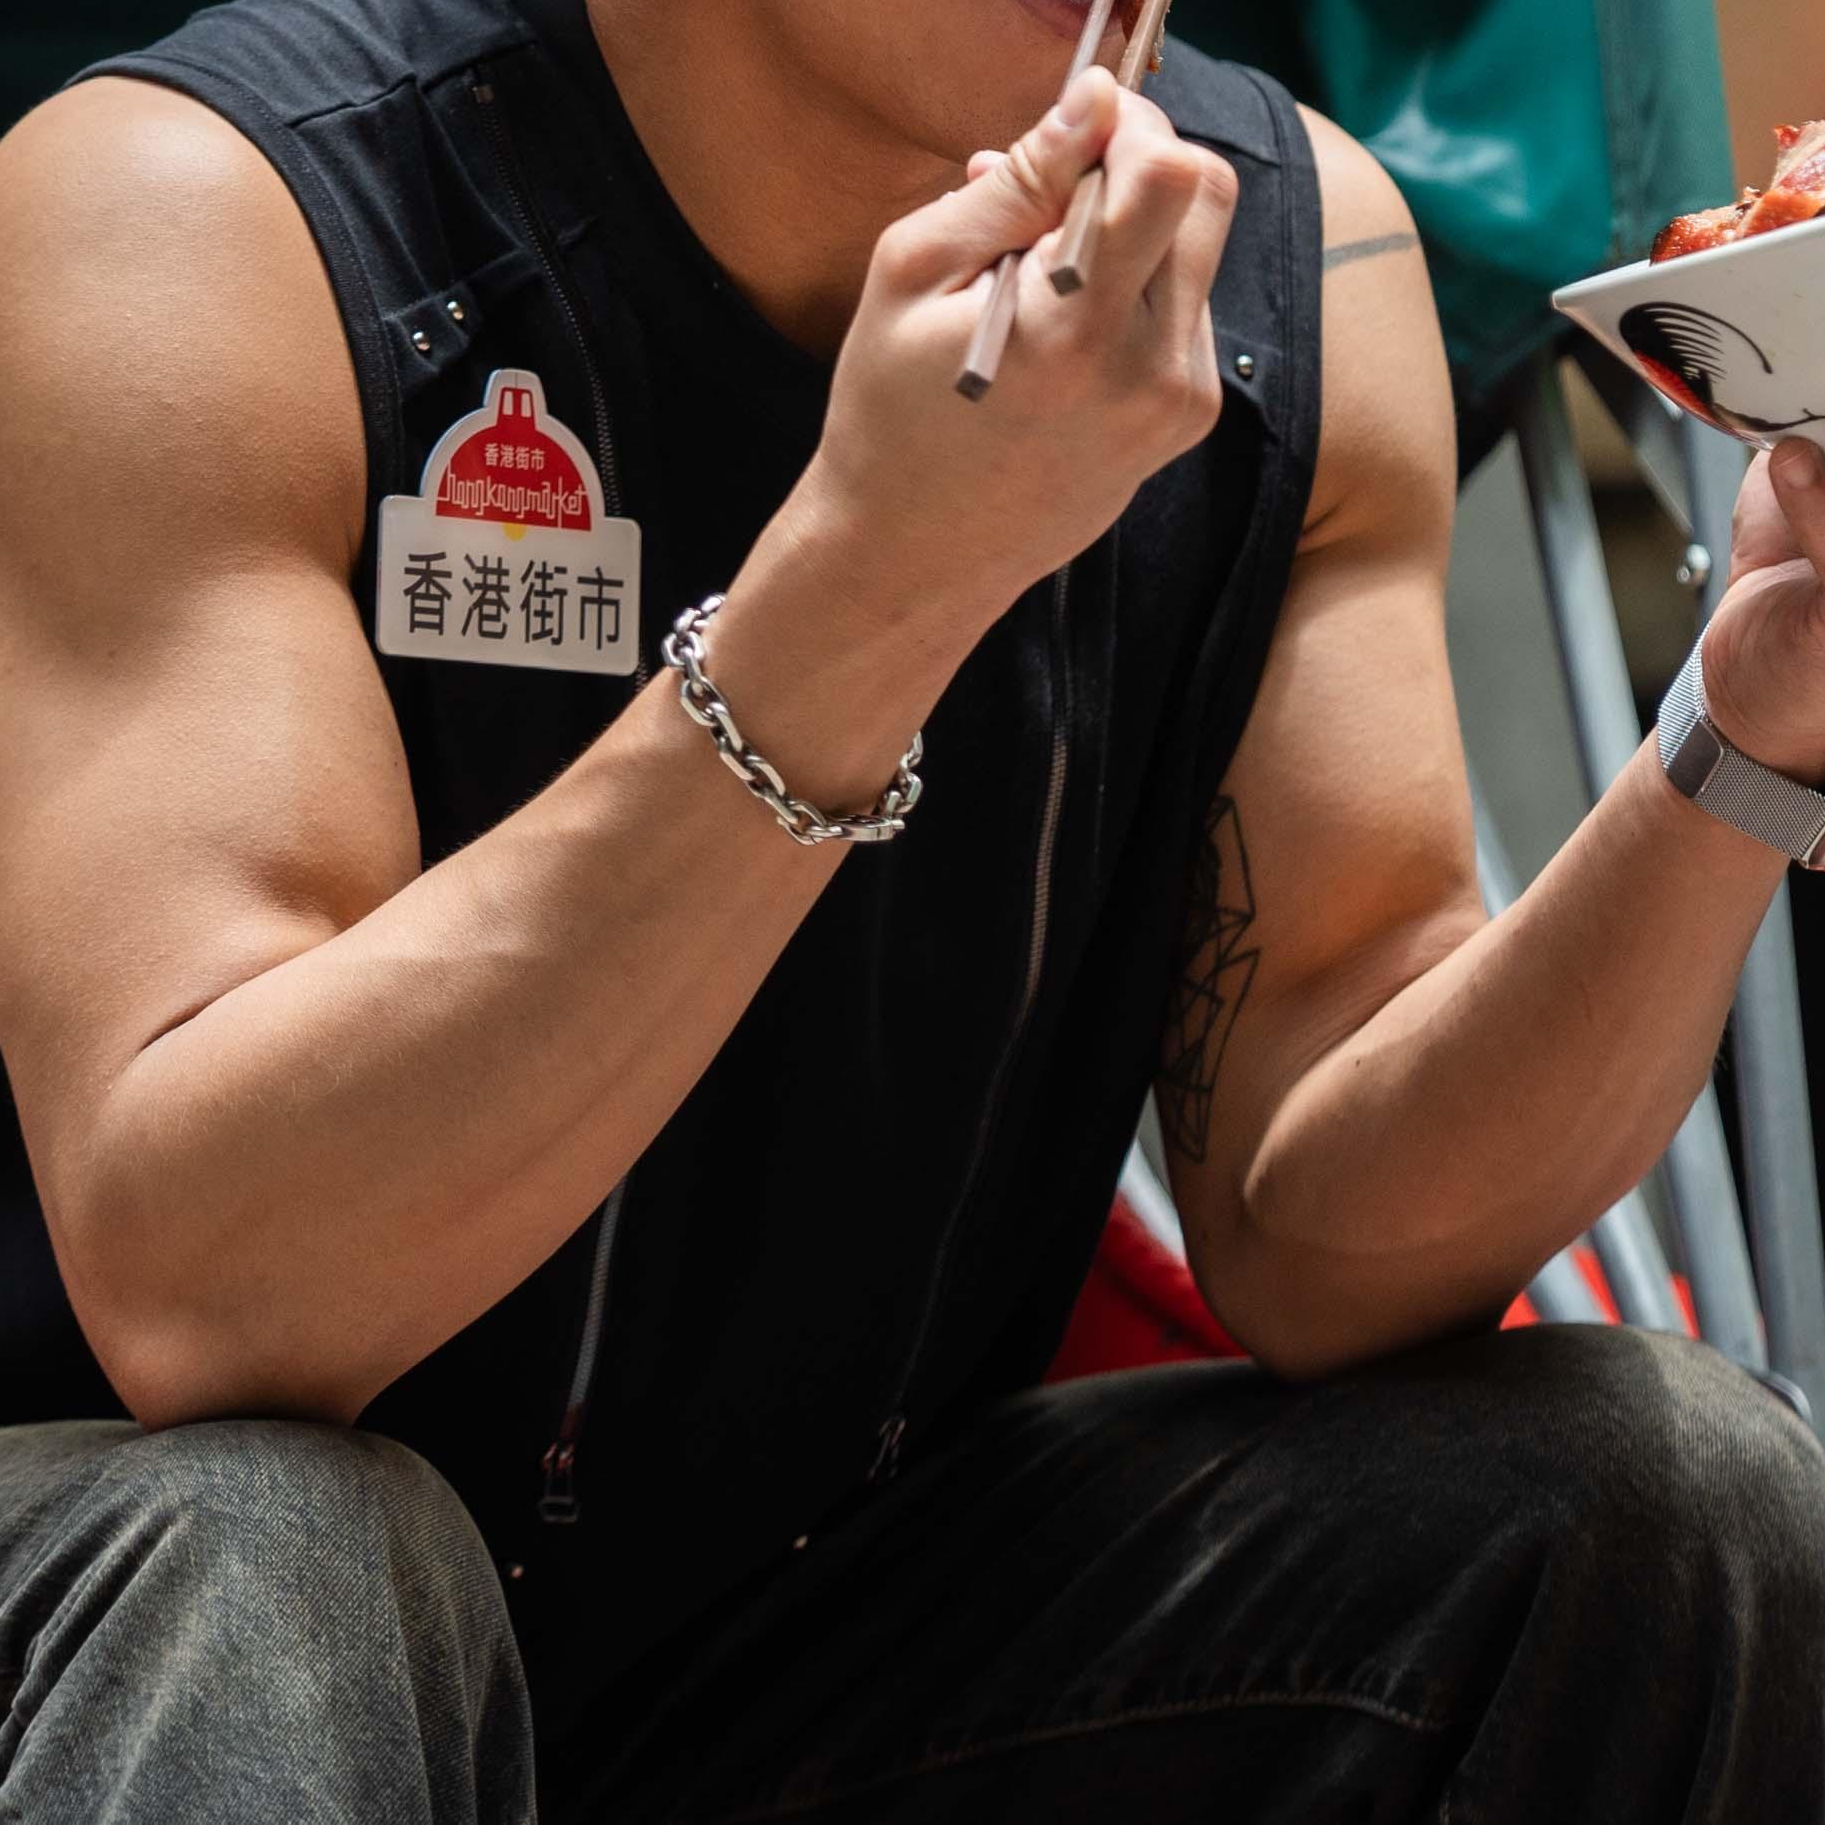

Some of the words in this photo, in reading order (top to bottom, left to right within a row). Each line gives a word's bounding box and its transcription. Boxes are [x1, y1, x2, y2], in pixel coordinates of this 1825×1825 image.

[484, 442, 545, 471] 香港街市
[402, 550, 625, 651] 香港街市
